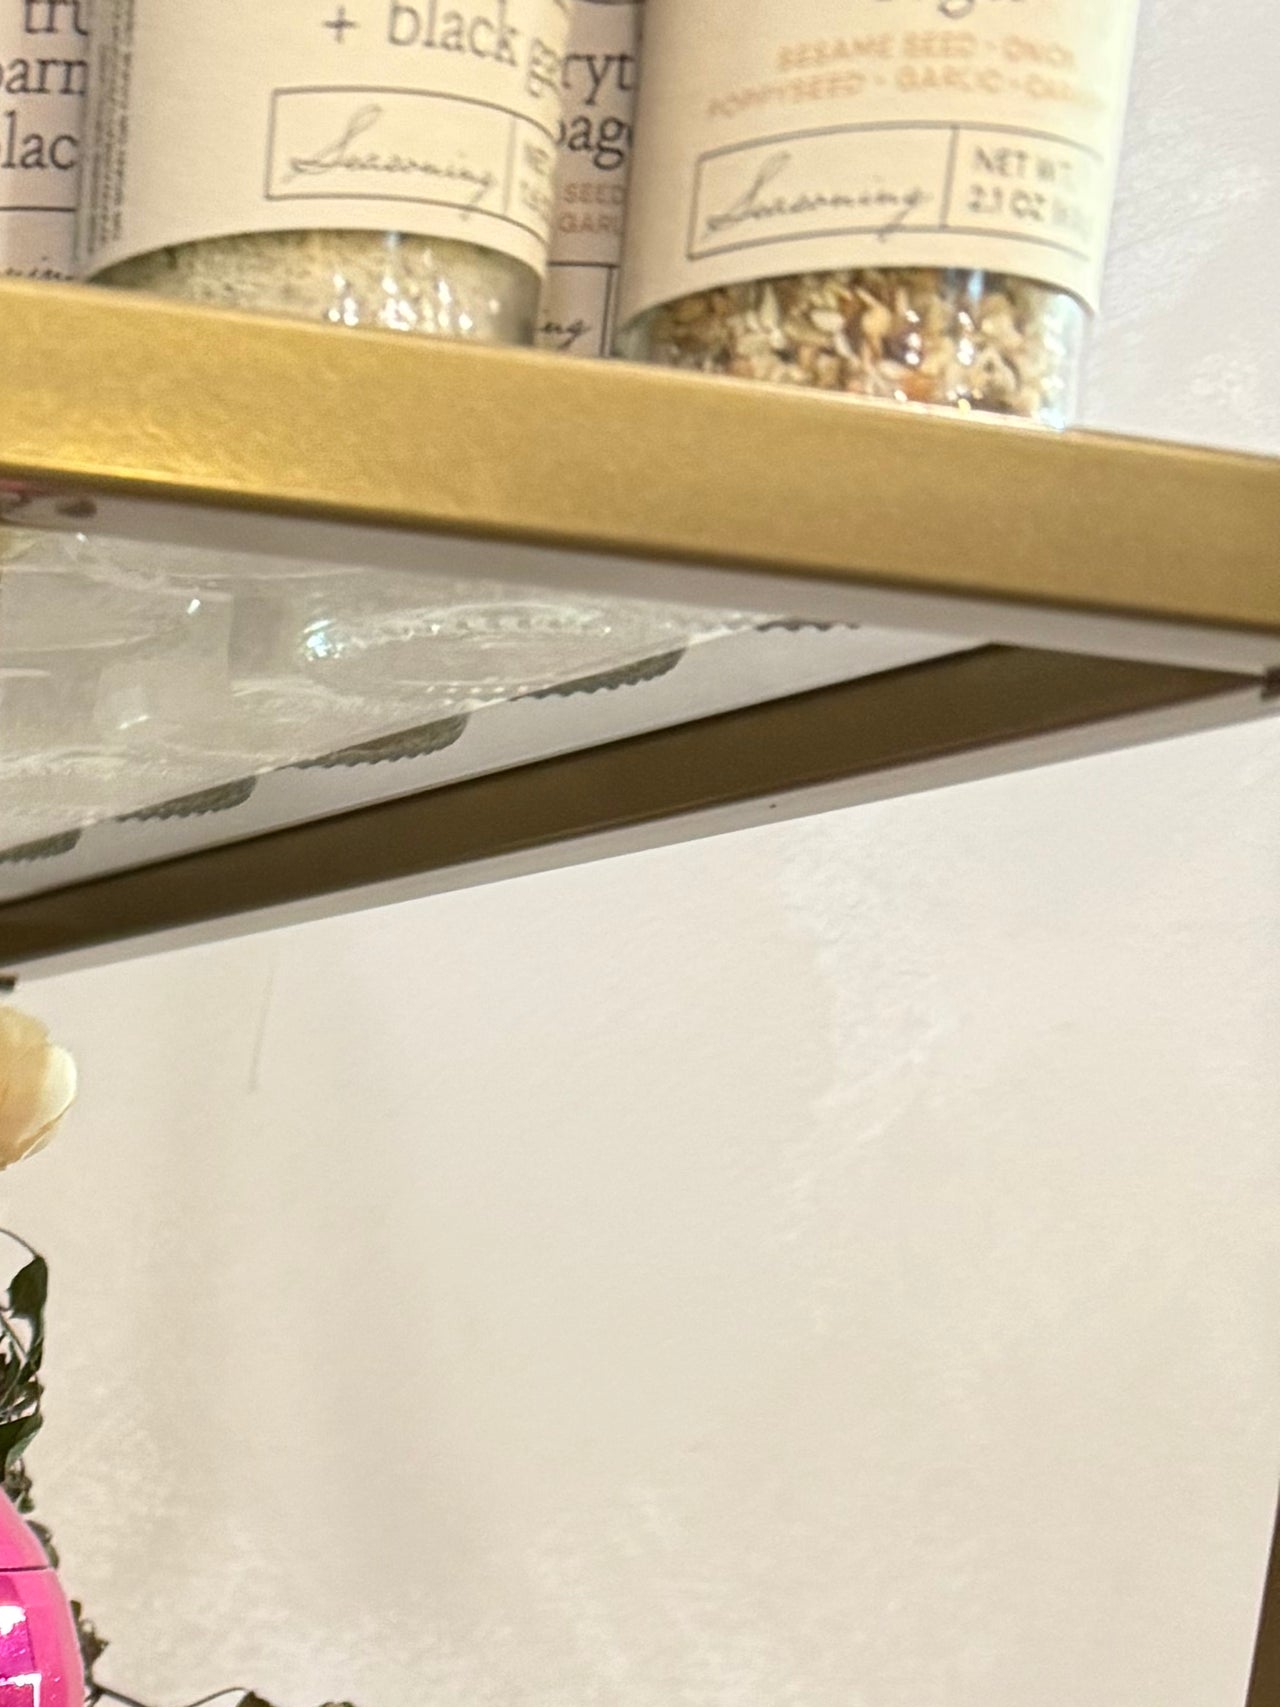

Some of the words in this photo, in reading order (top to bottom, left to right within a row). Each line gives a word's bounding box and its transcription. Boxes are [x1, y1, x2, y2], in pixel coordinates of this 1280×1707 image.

[387, 0, 519, 66] black
[282, 103, 496, 221] Seasoning
[703, 150, 932, 242] Seasoning
[974, 145, 1029, 179] NET
